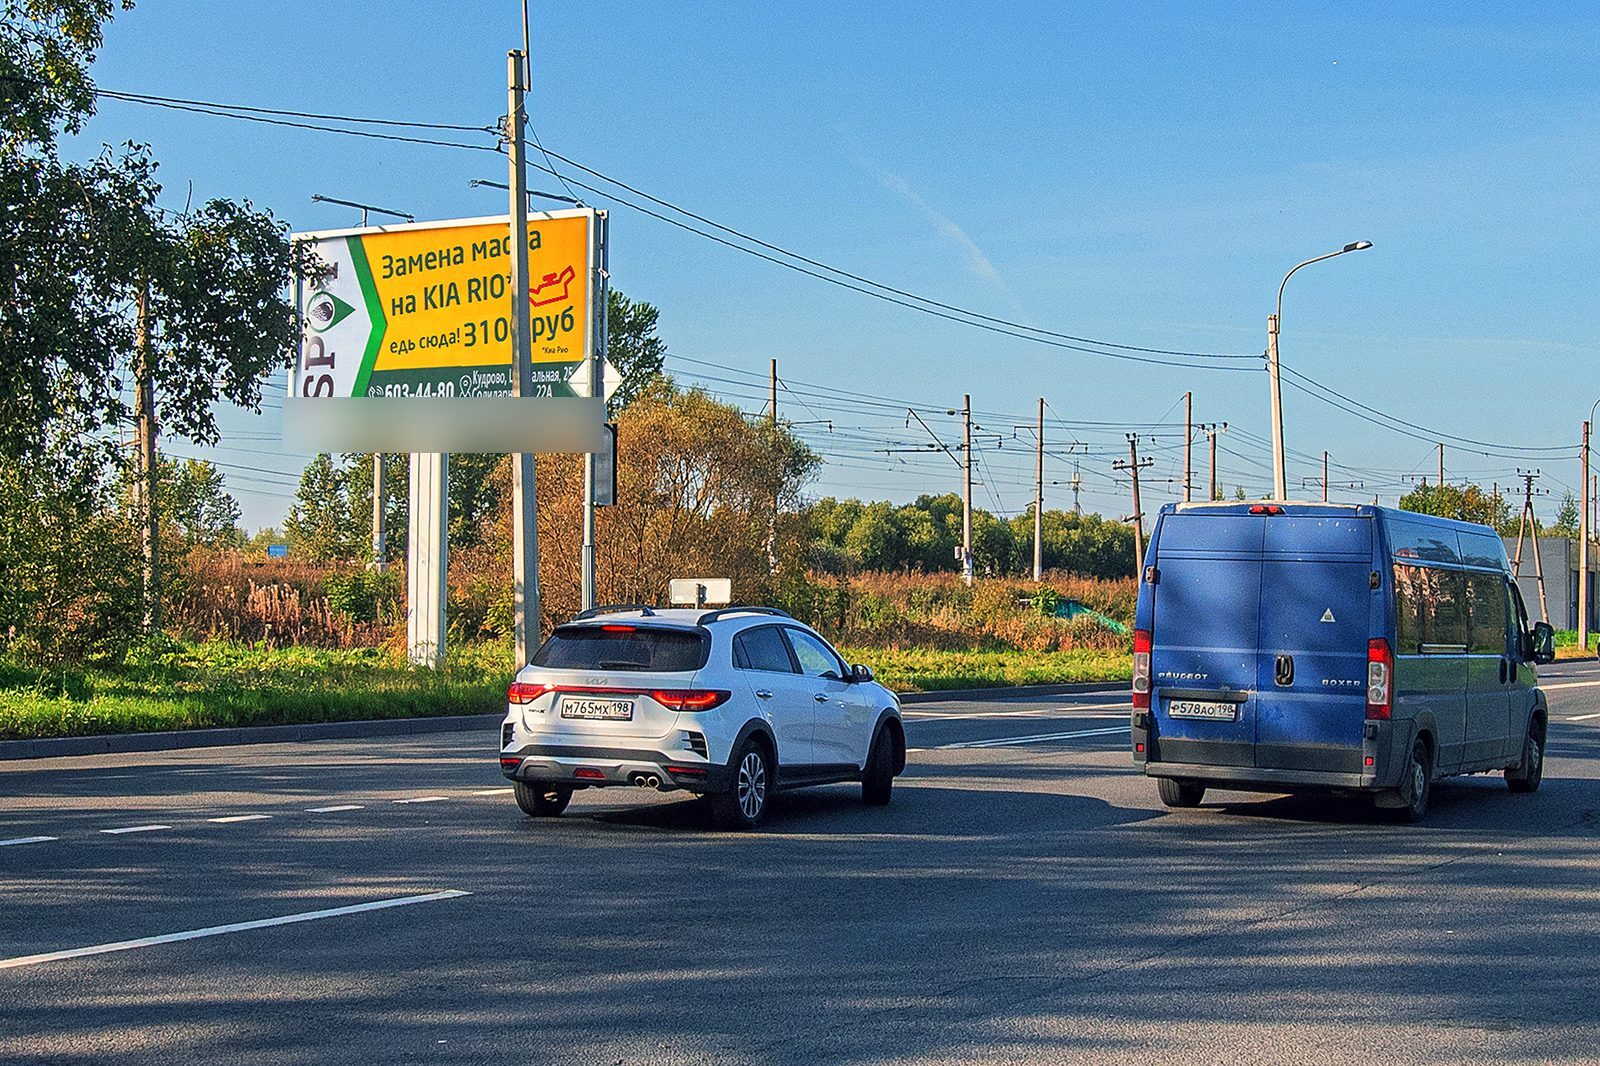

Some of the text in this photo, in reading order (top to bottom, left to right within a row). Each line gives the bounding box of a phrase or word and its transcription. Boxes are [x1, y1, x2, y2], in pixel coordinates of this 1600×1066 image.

[382, 230, 541, 279] Замена маса
[391, 294, 416, 317] на
[424, 281, 461, 310] KIA
[390, 306, 575, 355] едь сюда! 310 руб
[472, 369, 508, 388] Кудрово,
[385, 381, 455, 397] 603-44-80
[1158, 671, 1208, 680] PEUGEOT
[1321, 679, 1361, 687] BOXER
[564, 701, 629, 715] М765МХ 198
[1217, 704, 1233, 714] 198
